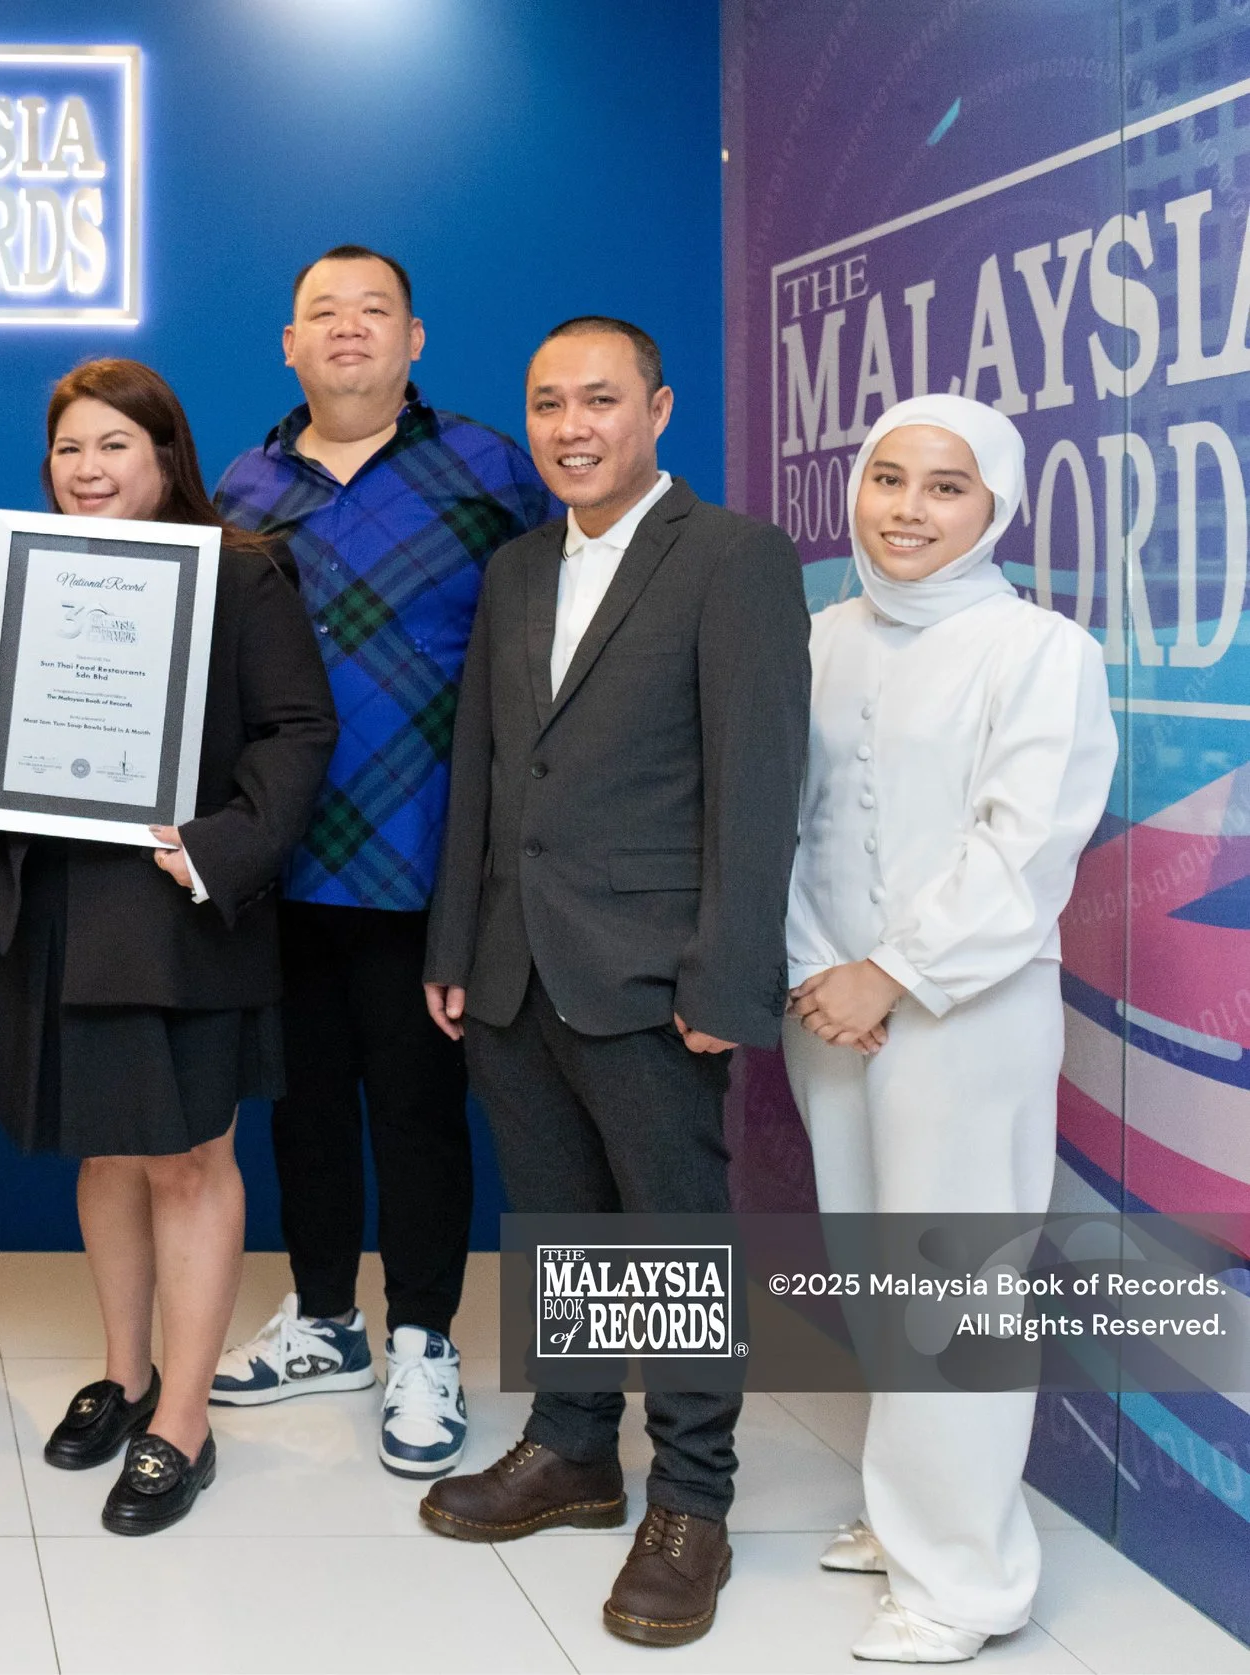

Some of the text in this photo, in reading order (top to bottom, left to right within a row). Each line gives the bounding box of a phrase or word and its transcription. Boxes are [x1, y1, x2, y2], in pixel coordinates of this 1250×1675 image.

[784, 253, 871, 320] THE
[784, 455, 856, 544] BOO
[56, 572, 148, 592] National Record
[57, 661, 74, 669] Thai
[75, 663, 96, 671] Food
[97, 665, 146, 677] Restaurants
[93, 673, 109, 681] Bhd
[109, 700, 132, 708] Records
